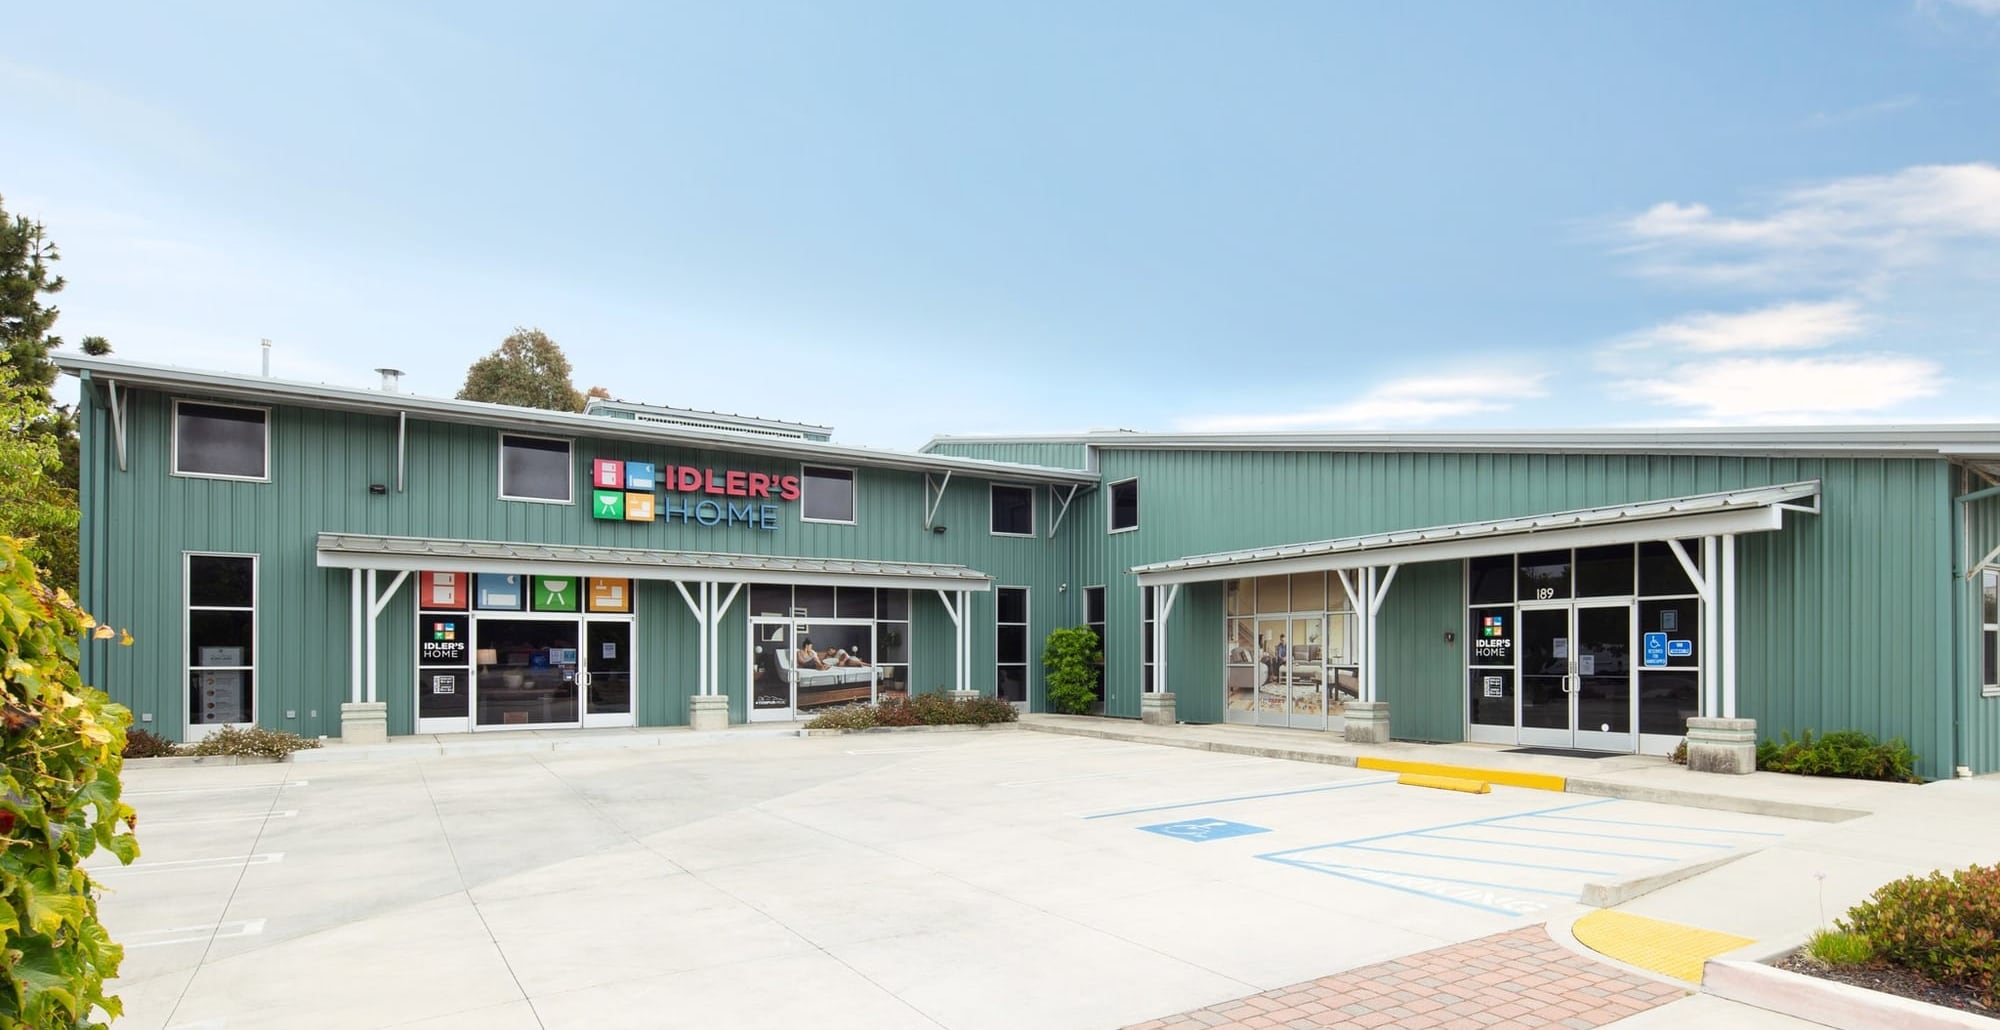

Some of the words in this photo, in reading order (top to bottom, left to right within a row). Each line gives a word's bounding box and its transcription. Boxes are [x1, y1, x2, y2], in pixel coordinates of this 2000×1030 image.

[666, 465, 800, 500] IDLER'S
[665, 496, 779, 530] HOME
[1536, 587, 1554, 600] 189
[423, 642, 465, 650] IDLER'S
[1475, 639, 1511, 648] IDLER'S
[423, 650, 459, 658] HOME
[1475, 648, 1506, 657] HOME
